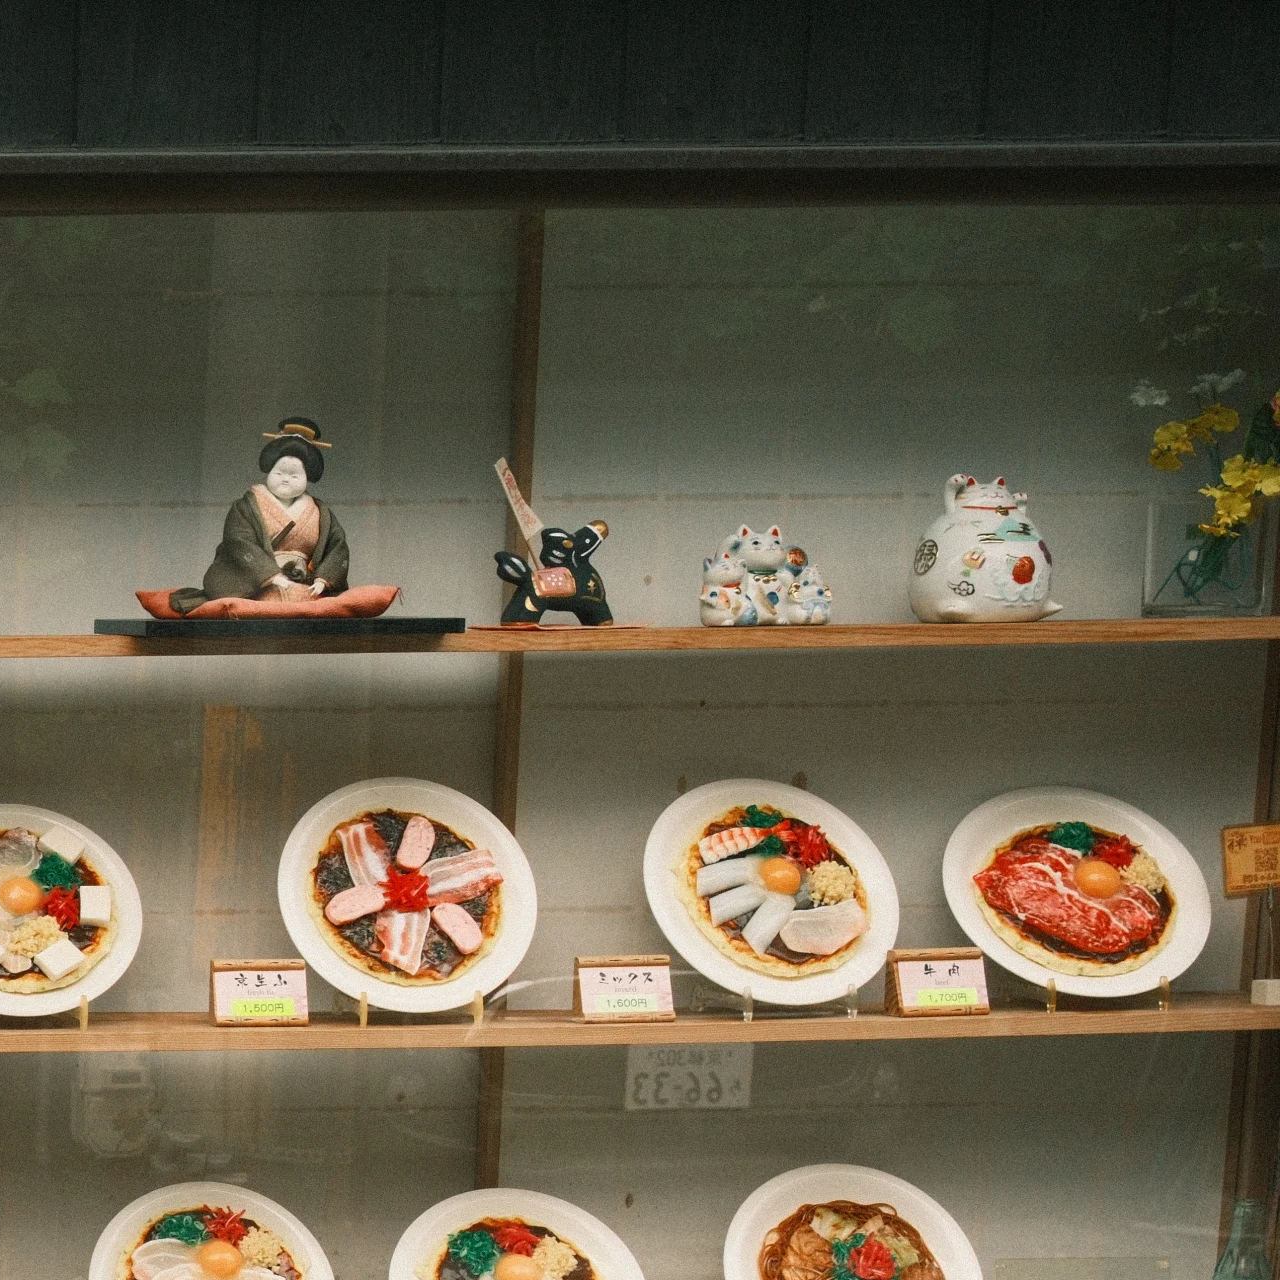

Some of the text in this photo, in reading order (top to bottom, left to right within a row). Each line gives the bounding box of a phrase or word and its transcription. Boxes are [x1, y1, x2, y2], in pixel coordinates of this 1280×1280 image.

[923, 963, 961, 977] 牛肉
[598, 971, 654, 985] ミックス
[606, 998, 648, 1009] 1,600円
[928, 992, 967, 1003] 1,700円
